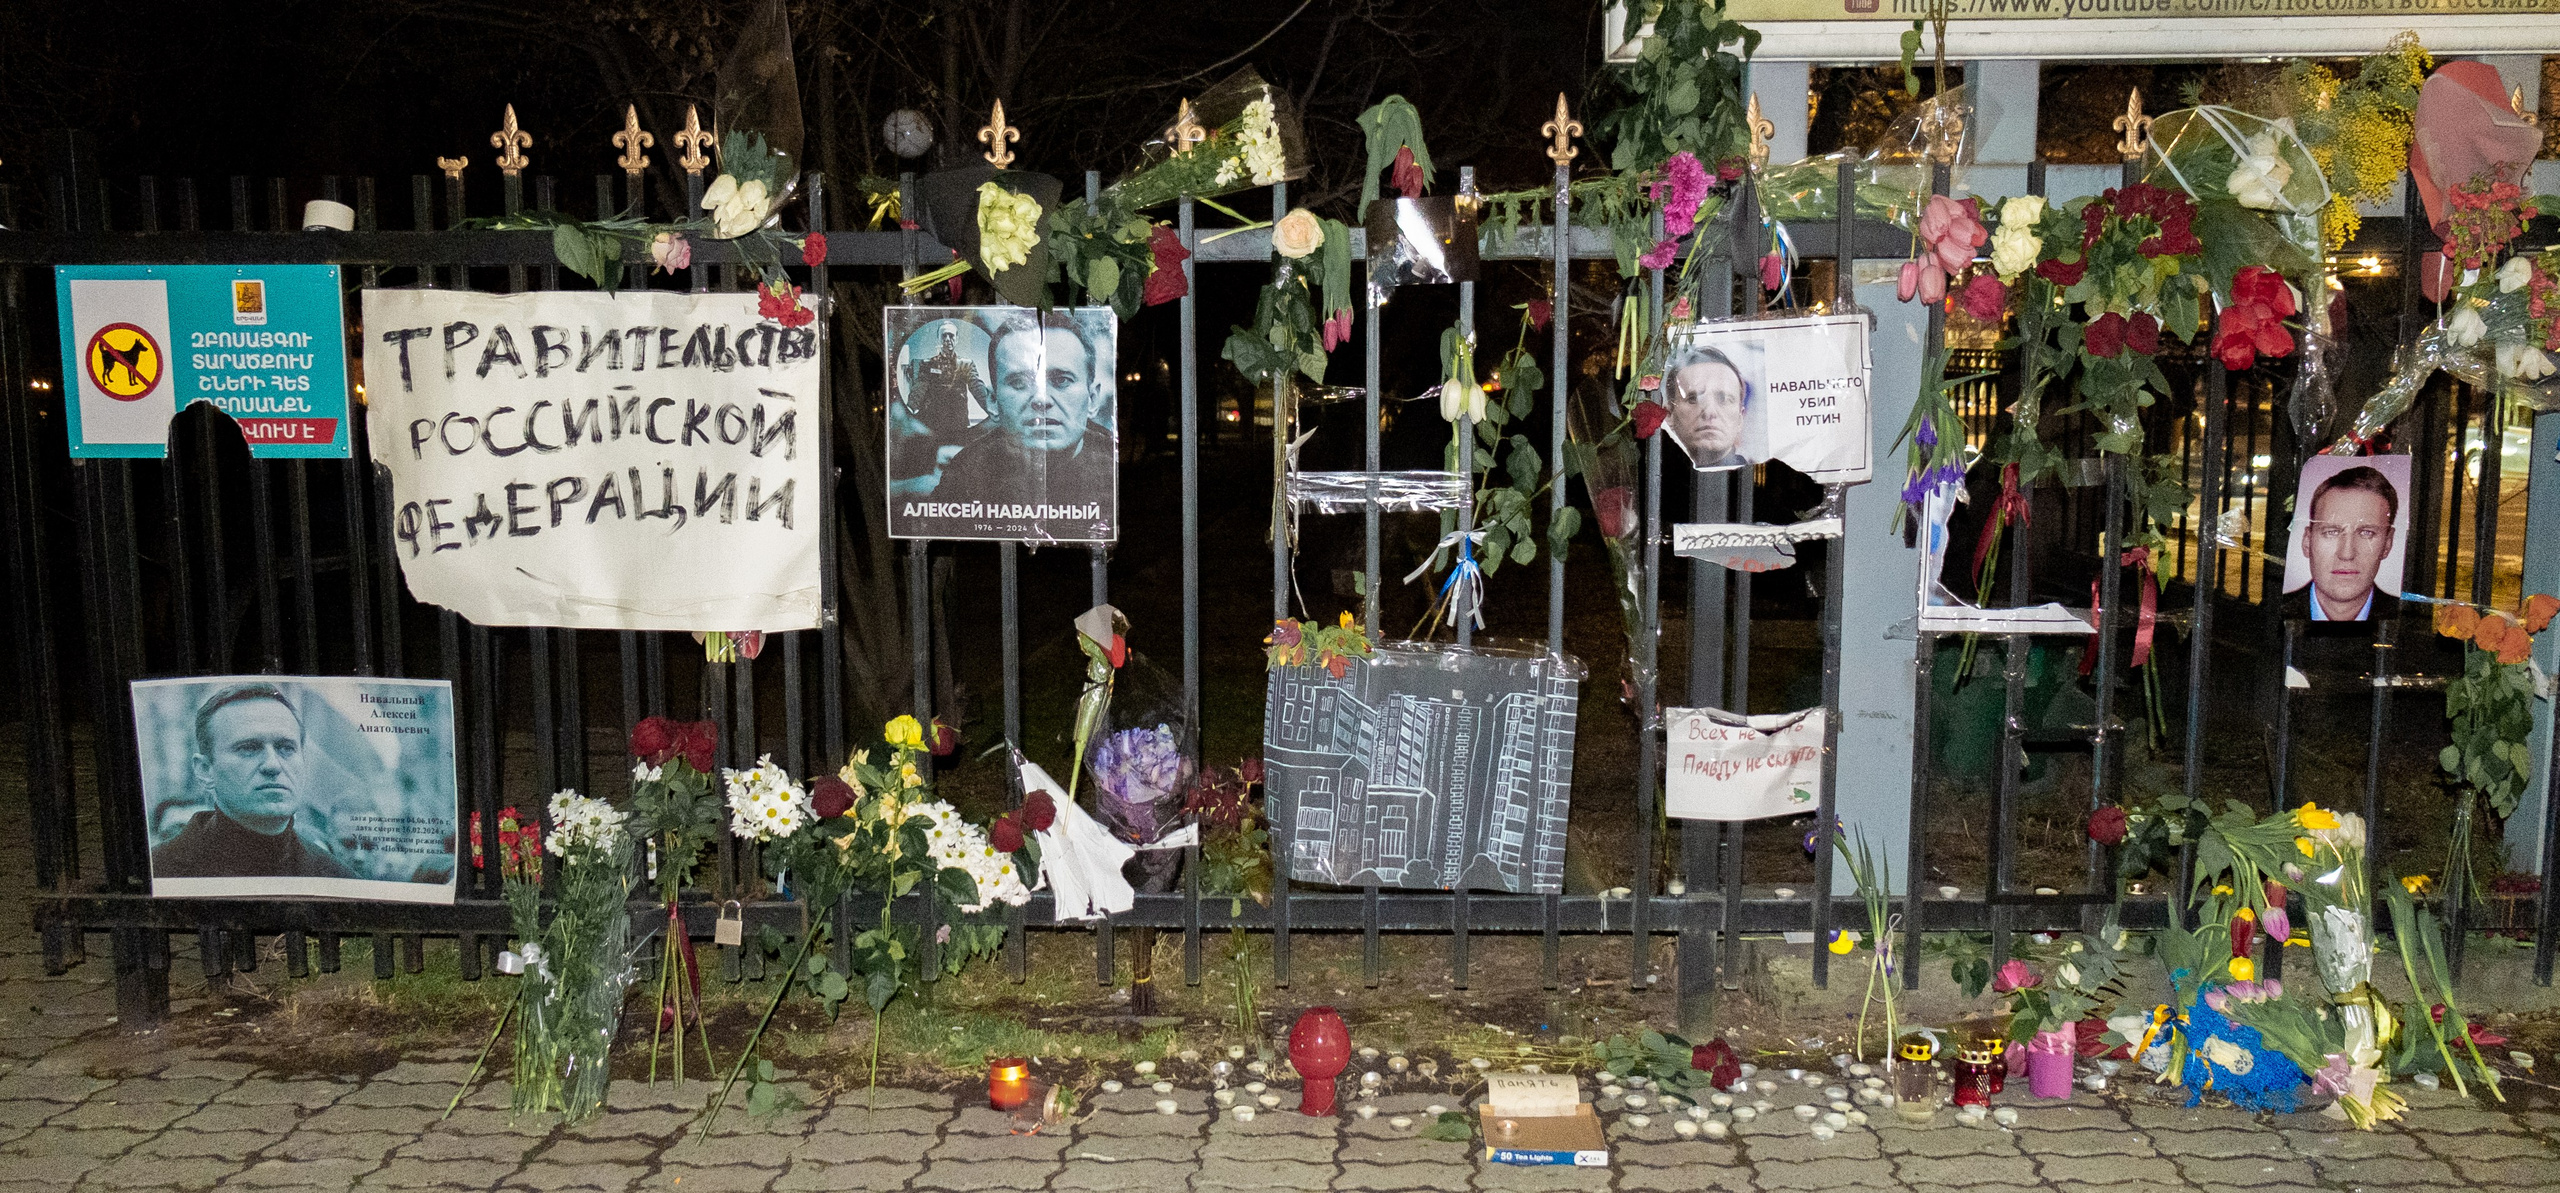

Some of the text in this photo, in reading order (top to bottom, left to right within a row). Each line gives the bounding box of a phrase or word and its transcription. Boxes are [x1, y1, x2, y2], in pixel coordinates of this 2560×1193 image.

[191, 332, 313, 348] ԶԲՈՍԱՅԳՈՒ
[192, 354, 314, 369] ՏԱՐԱԾՔՈՒՄ
[199, 376, 310, 391] ՇՆԵՐԻ ՀԵՏ
[190, 397, 311, 412] ԲՈՍԱՆՔՆ
[1799, 396, 1835, 408] УБИЛ
[409, 385, 797, 461] РОССИЙСКОЙ
[1796, 413, 1840, 426] ПУТИН
[303, 424, 315, 438] Է
[396, 463, 796, 558] ФЕДЕРАЦИИ
[903, 501, 1100, 520] АЛЕКСЕЙ НАВАЛЬНЫЙ
[360, 693, 425, 705] Навальный
[370, 709, 417, 719] Алексей
[357, 723, 430, 735] Анатольевич
[1689, 718, 1756, 741] Всех не
[1500, 1151, 1512, 1160] 50
[1529, 1154, 1554, 1162] Lights
